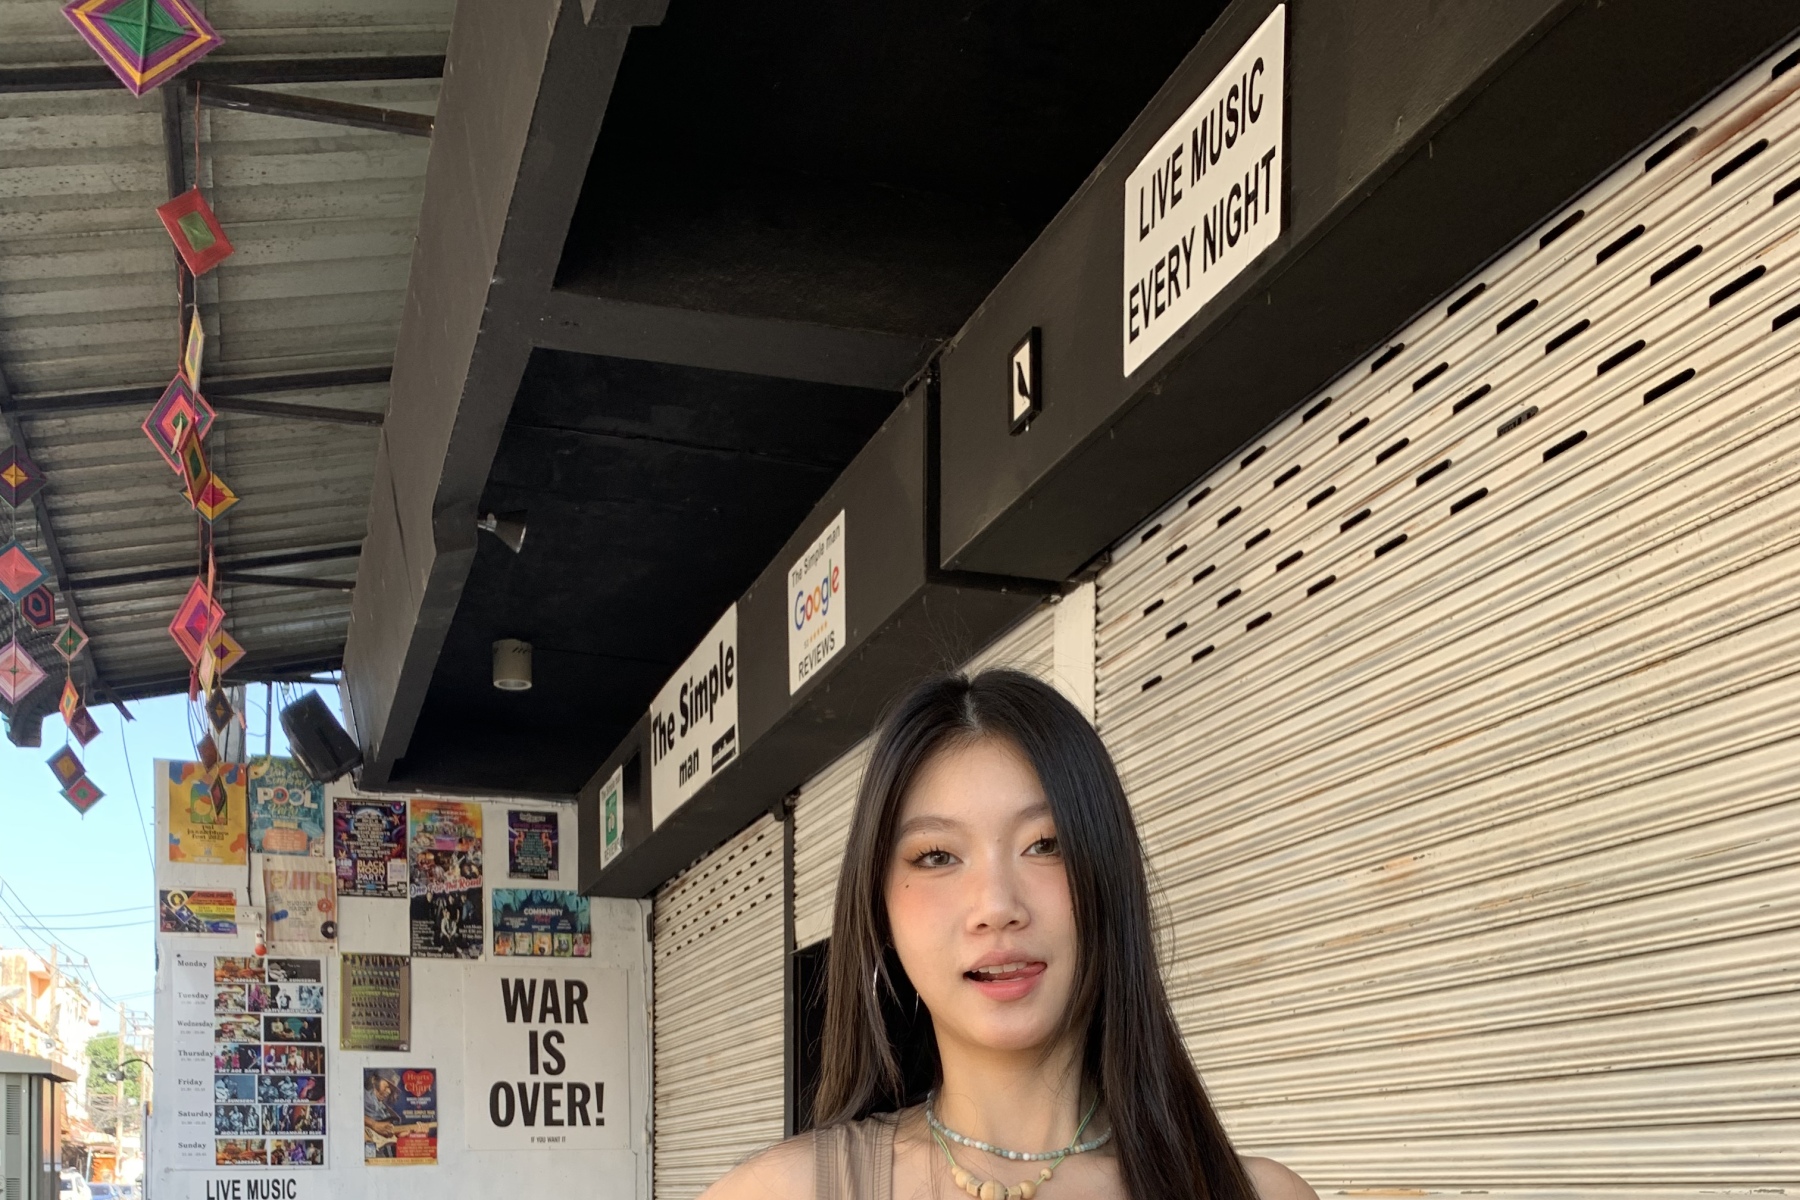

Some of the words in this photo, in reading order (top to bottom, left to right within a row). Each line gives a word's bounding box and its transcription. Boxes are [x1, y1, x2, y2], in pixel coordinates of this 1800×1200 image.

[1138, 142, 1184, 243] LIVE
[1190, 57, 1265, 188] MUSIC
[1128, 225, 1196, 345] EVERY
[1202, 145, 1277, 274] NIGHT
[791, 567, 803, 588] The
[804, 542, 825, 576] Simple
[825, 524, 841, 546] man
[794, 558, 840, 631] Google
[798, 630, 836, 682] REVIEWS
[652, 711, 676, 767] The
[679, 640, 735, 738] Simple
[679, 748, 700, 788] man
[256, 786, 319, 809] POOL
[357, 860, 385, 869] BLACK
[357, 867, 386, 875] MOON
[357, 873, 385, 882] PARTY
[459, 875, 483, 891] Road
[523, 907, 564, 916] COMMUNITY
[177, 959, 208, 968] Monday
[178, 992, 210, 1000] Tuesday
[500, 977, 589, 1025] WAR
[177, 1020, 214, 1028] Wednesday
[178, 1050, 214, 1058] Thursday
[528, 1029, 567, 1076] IS
[178, 1078, 203, 1087] Friday
[489, 1080, 605, 1128] OVER!
[178, 1110, 213, 1118] Saturday
[178, 1142, 207, 1150] Sunday
[206, 1179, 242, 1200] LIVE
[247, 1178, 298, 1200] MUSIC
